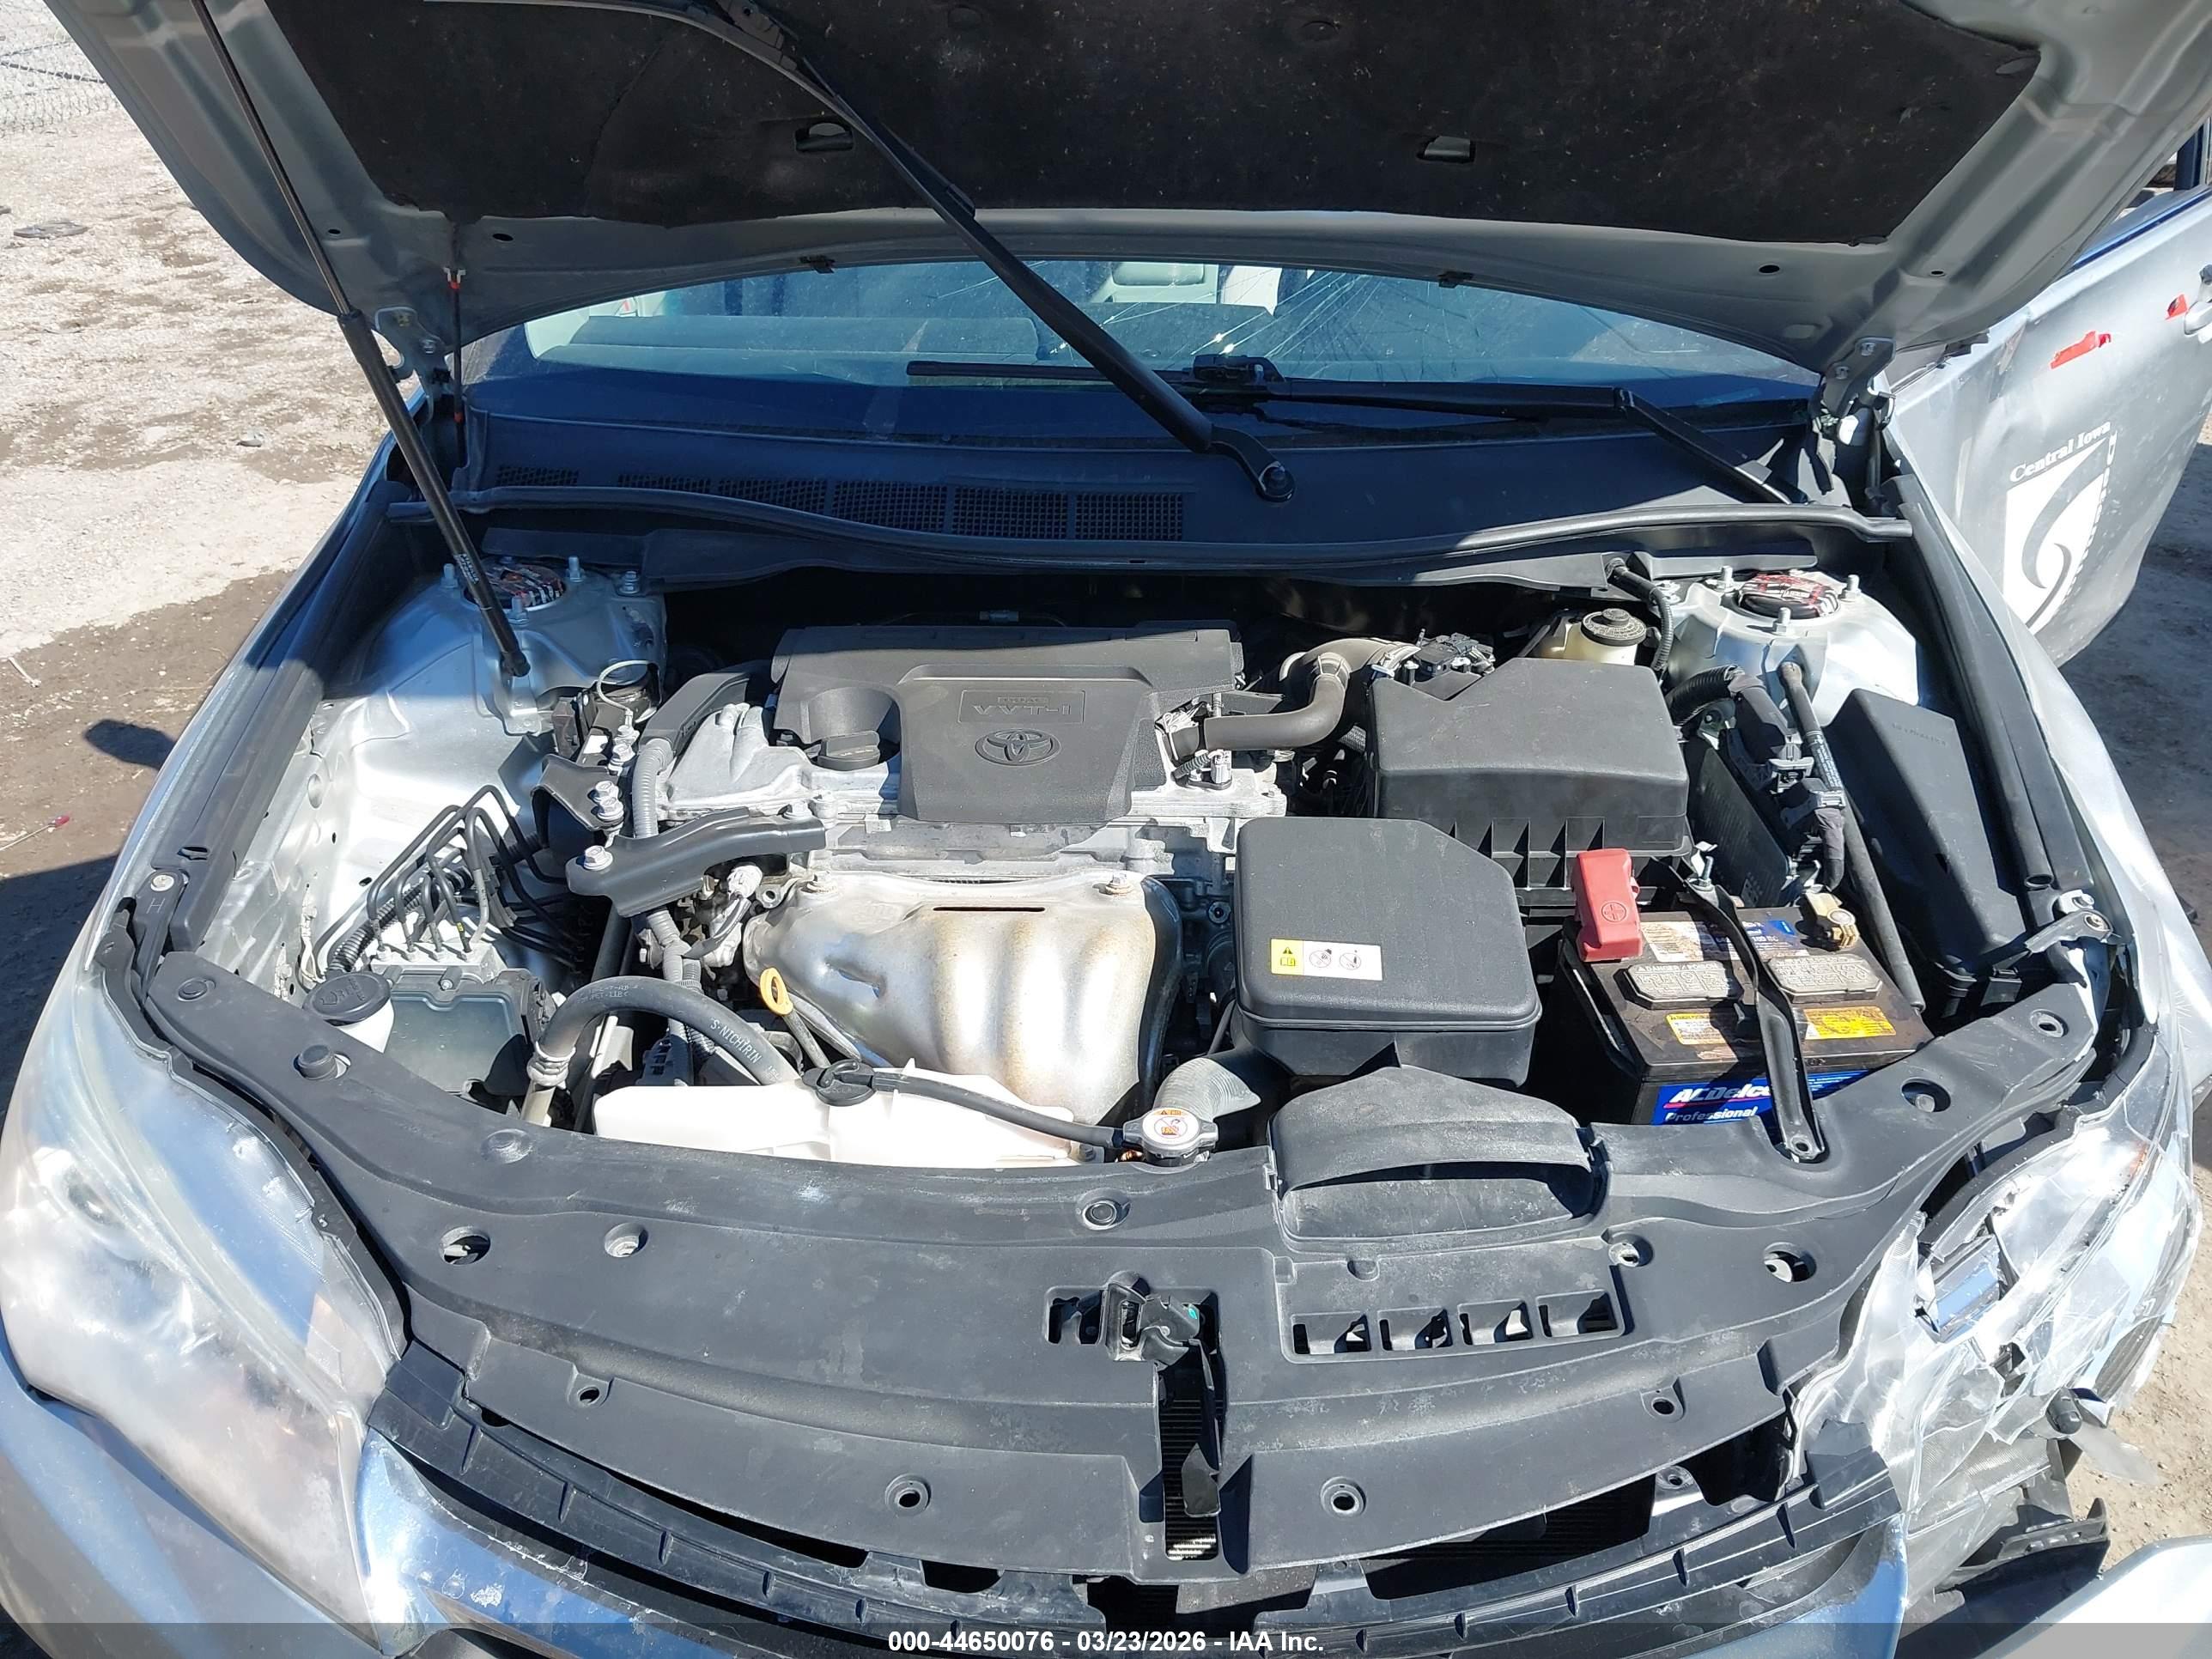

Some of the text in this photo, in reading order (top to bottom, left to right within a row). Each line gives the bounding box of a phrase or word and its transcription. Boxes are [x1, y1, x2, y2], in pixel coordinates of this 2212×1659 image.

[2009, 421, 2111, 483] Central Iowa
[1665, 1106, 1759, 1121] Professional
